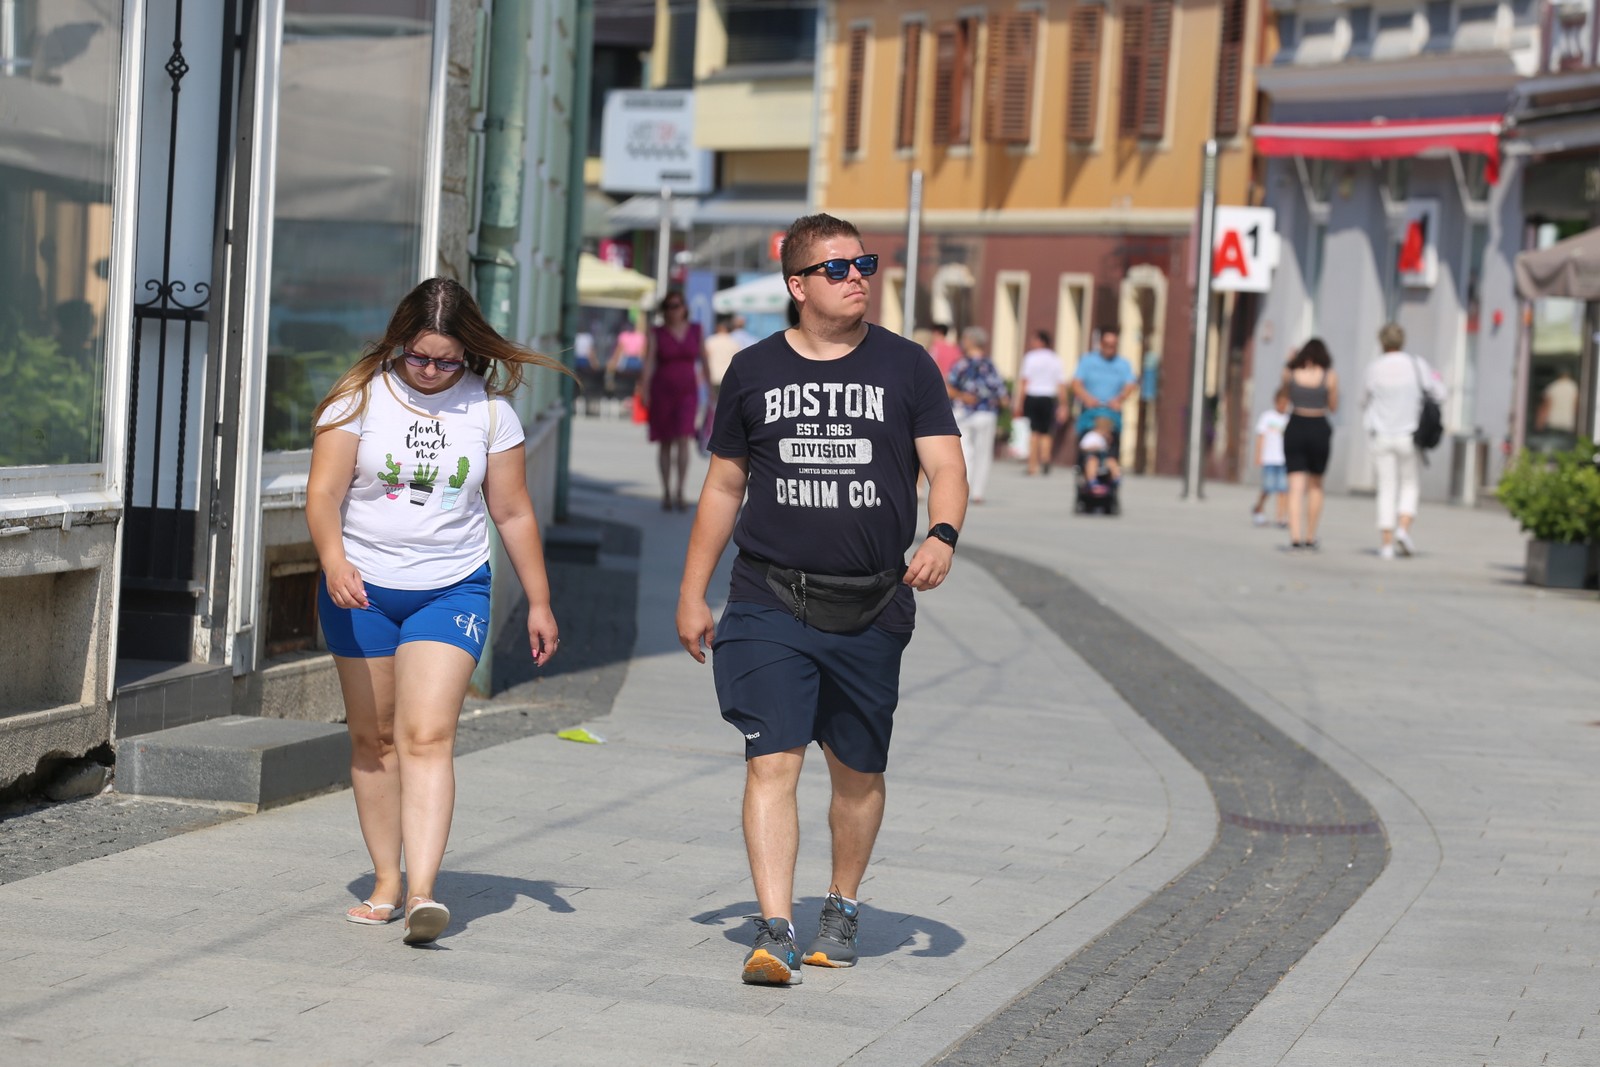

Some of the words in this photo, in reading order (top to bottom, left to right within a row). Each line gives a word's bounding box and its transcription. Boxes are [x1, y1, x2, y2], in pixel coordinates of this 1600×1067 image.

[1212, 226, 1259, 278] A1
[764, 382, 884, 424] BOSTON
[408, 419, 445, 438] don't
[796, 423, 823, 436] EST.
[826, 423, 852, 436] 1963
[404, 433, 452, 450] touch
[415, 448, 438, 460] me
[791, 442, 857, 459] DIVISION
[798, 467, 820, 475] LIMITED
[776, 477, 838, 508] DENIM
[848, 479, 882, 509] CO.
